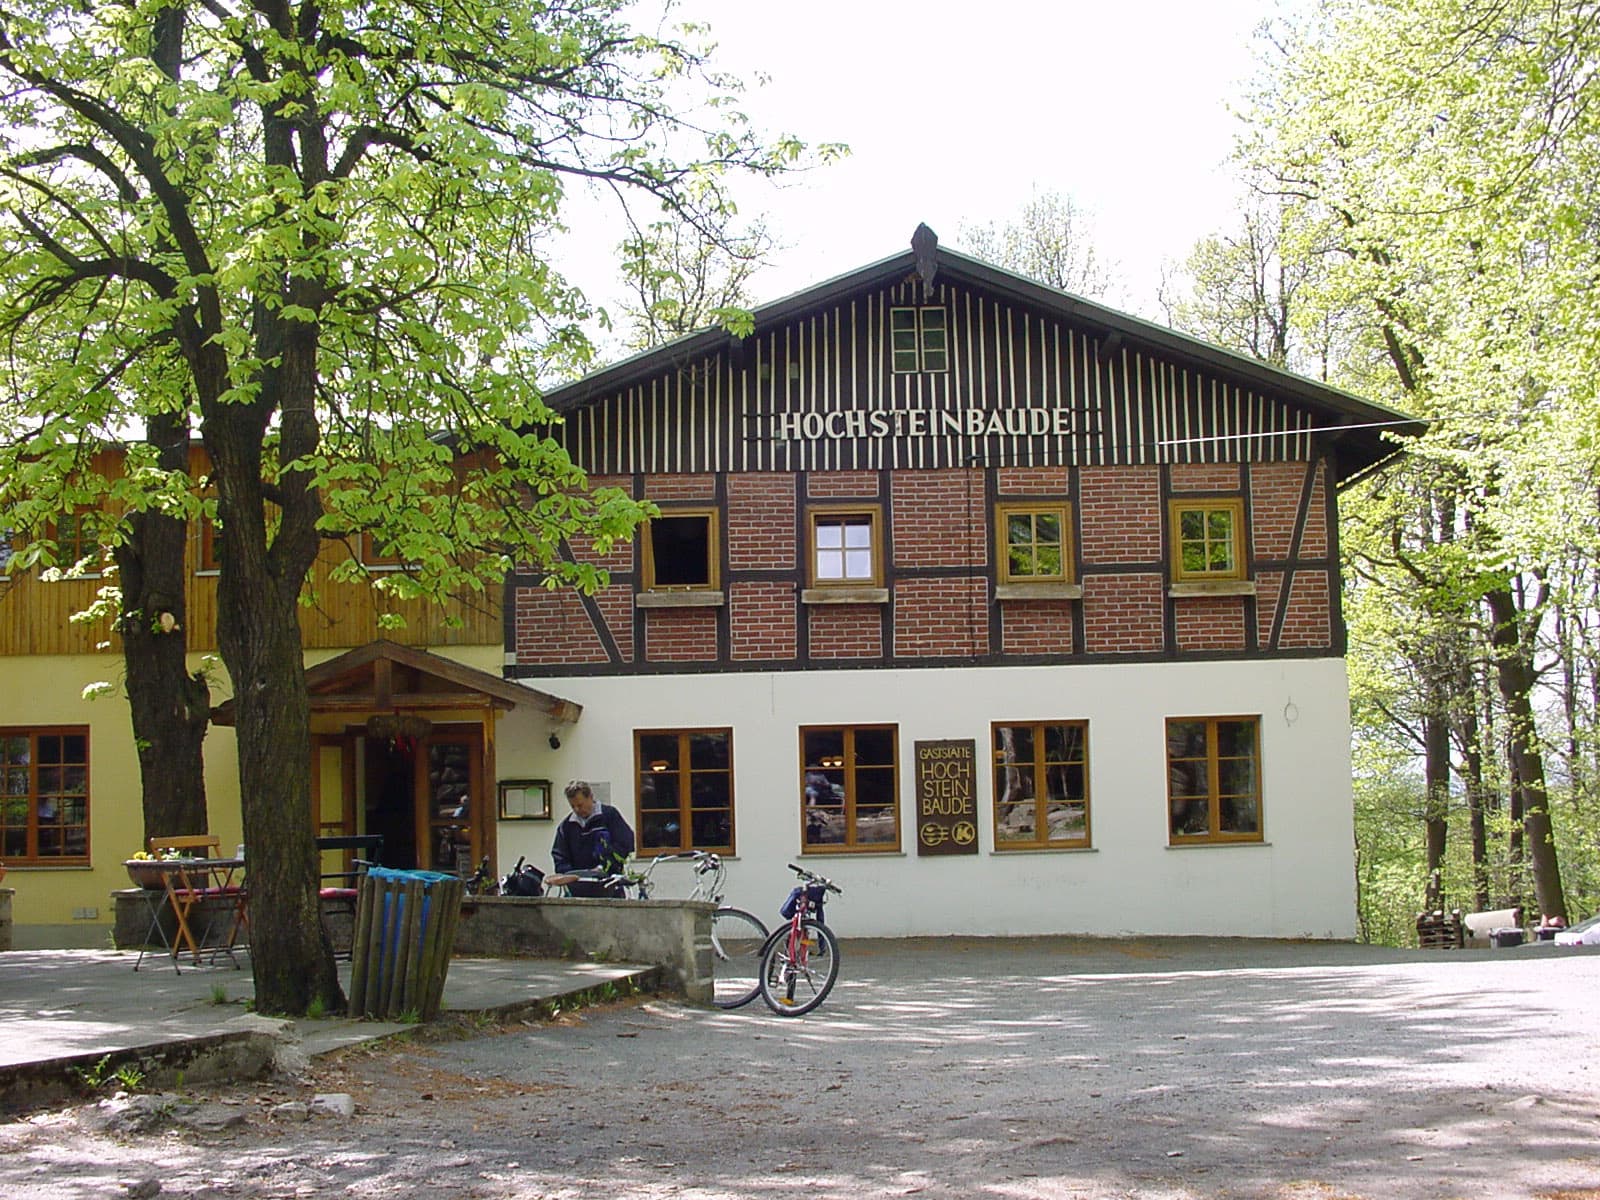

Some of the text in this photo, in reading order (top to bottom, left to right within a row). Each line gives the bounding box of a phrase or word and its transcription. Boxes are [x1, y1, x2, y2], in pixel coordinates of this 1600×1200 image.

[780, 407, 1070, 440] HOCHSTEINBAUDE
[921, 761, 970, 779] HOCH
[924, 779, 969, 798] STEIN
[923, 797, 972, 816] BAUDE
